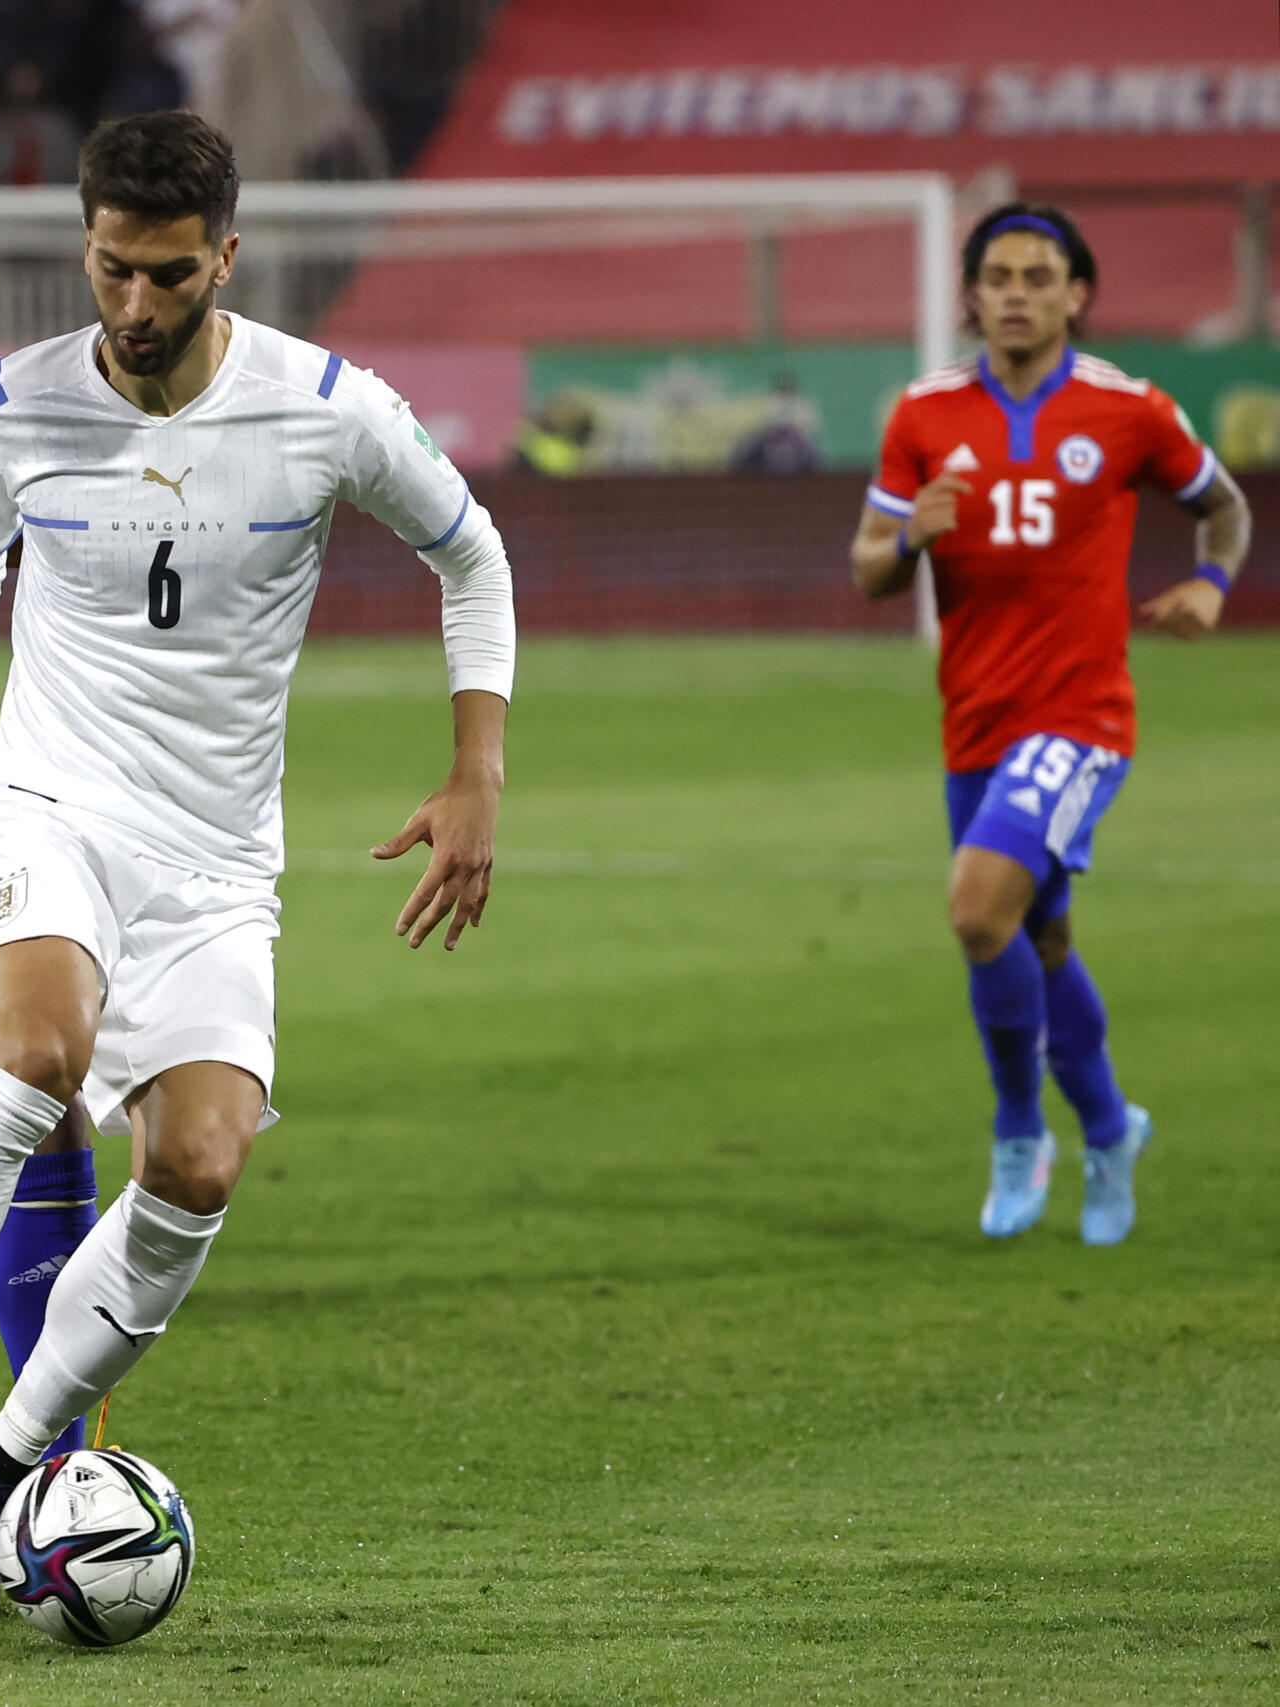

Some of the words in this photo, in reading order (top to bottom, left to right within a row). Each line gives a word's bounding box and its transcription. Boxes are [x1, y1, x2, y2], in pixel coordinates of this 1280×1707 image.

[111, 521, 225, 532] URUGUAY
[988, 479, 1057, 547] 15
[148, 540, 182, 630] 6
[1006, 732, 1081, 793] 15
